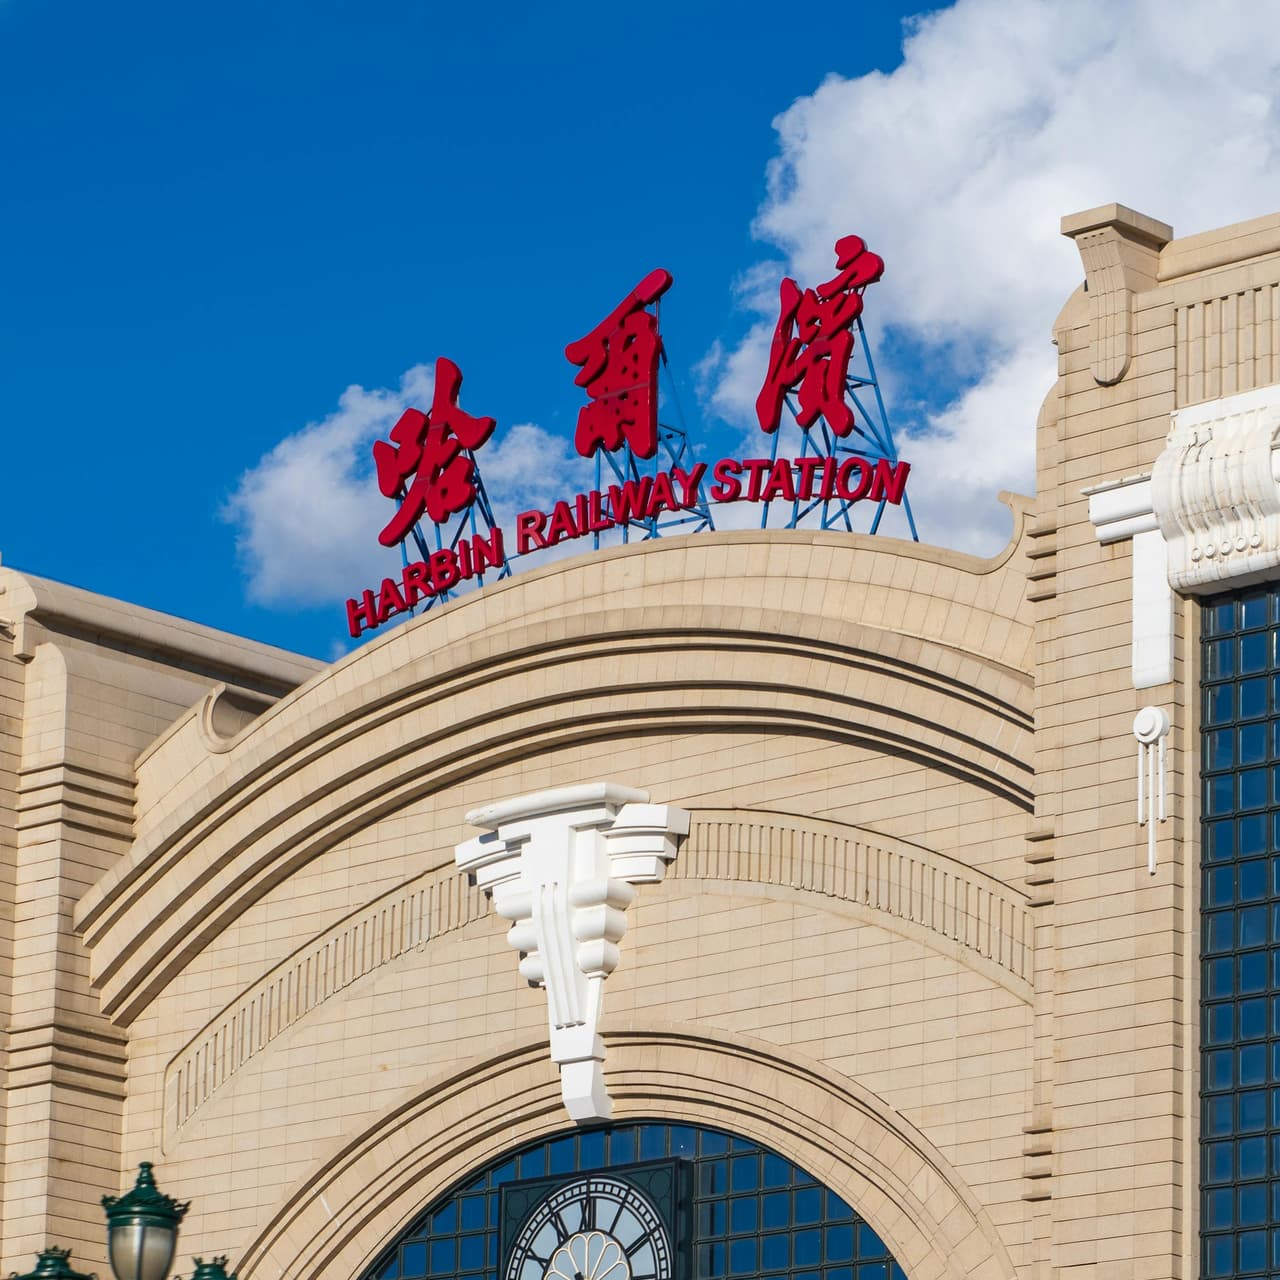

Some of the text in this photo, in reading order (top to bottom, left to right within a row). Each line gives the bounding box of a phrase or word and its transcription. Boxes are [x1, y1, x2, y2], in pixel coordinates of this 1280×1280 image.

[346, 456, 911, 638] HARBIN RAILWAY STATION
[549, 1212, 569, 1243] XI
[580, 1199, 597, 1231] XII
[524, 1249, 549, 1269] X
[625, 1231, 653, 1257] II
